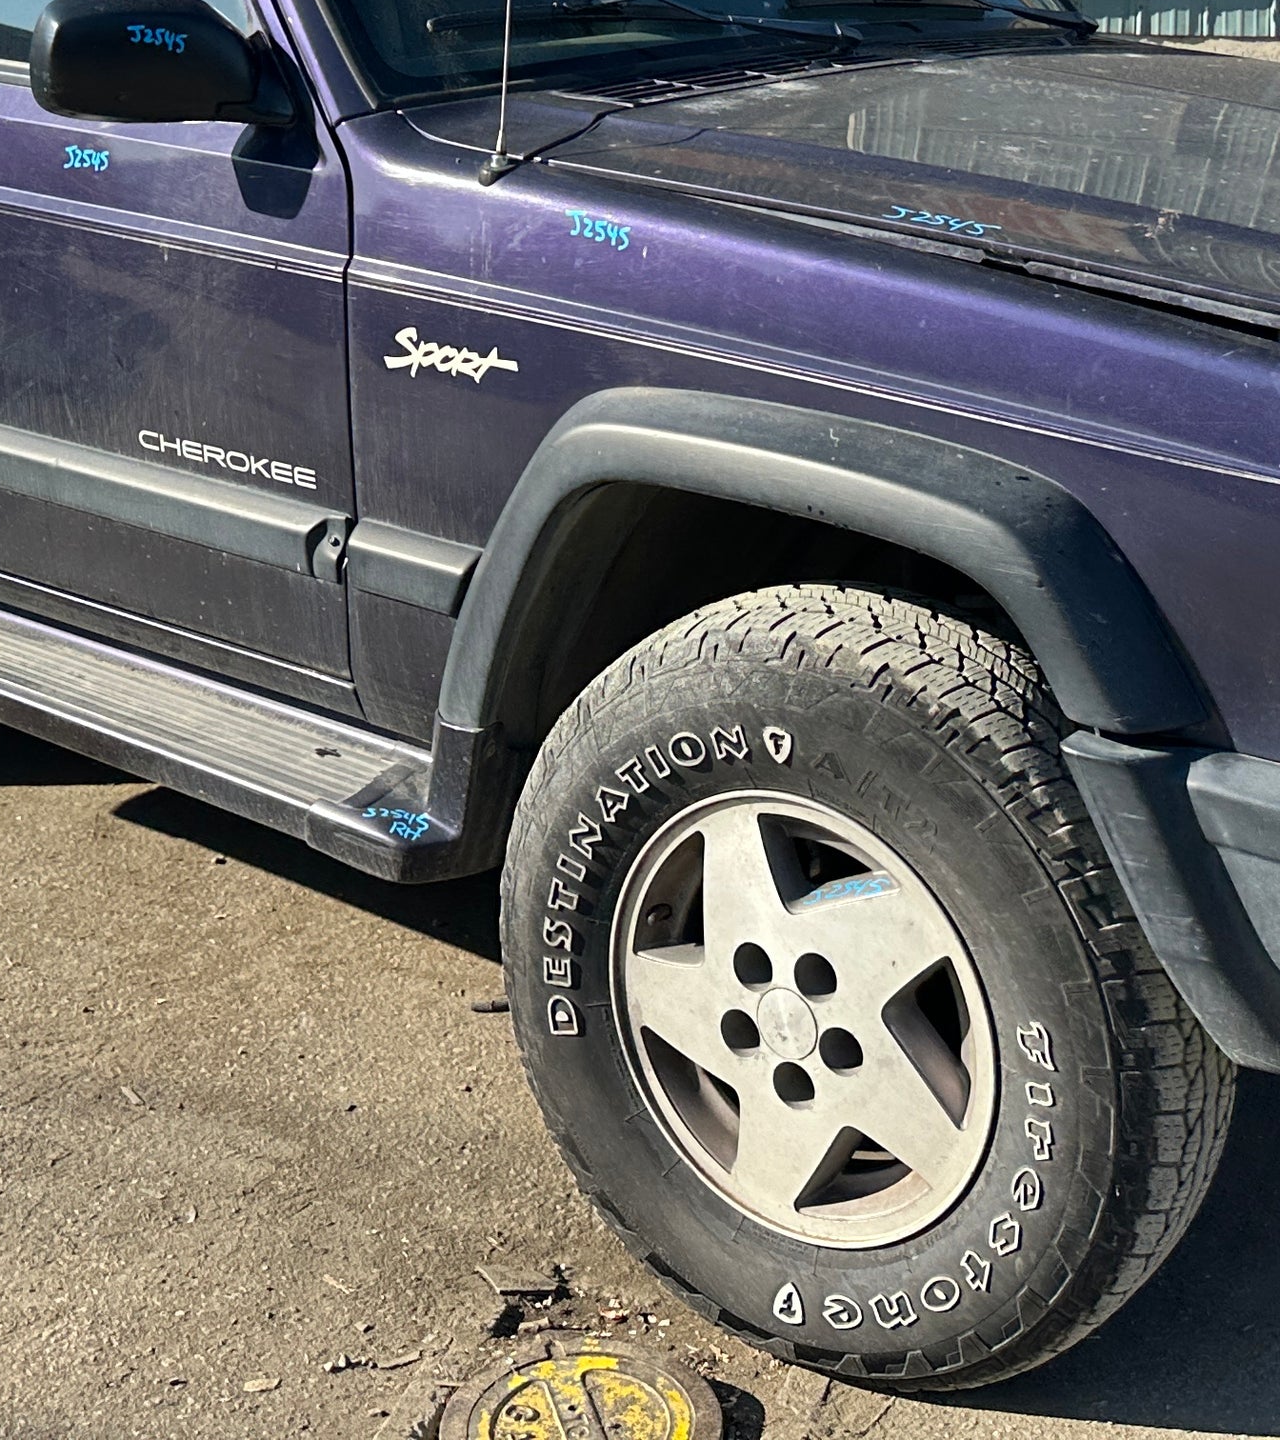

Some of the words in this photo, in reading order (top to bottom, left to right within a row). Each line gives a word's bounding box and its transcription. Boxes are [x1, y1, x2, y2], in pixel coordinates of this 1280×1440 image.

[127, 25, 188, 53] J2545
[64, 145, 110, 171] J2545
[565, 209, 631, 251] J2545
[881, 205, 1001, 235] J2545
[383, 326, 519, 384] Sport
[138, 429, 317, 490] CHEROKEE
[389, 822, 421, 840] RH
[543, 724, 749, 1036] DESTINATION
[803, 877, 891, 905] J2545
[823, 1021, 1057, 1330] Firestone
